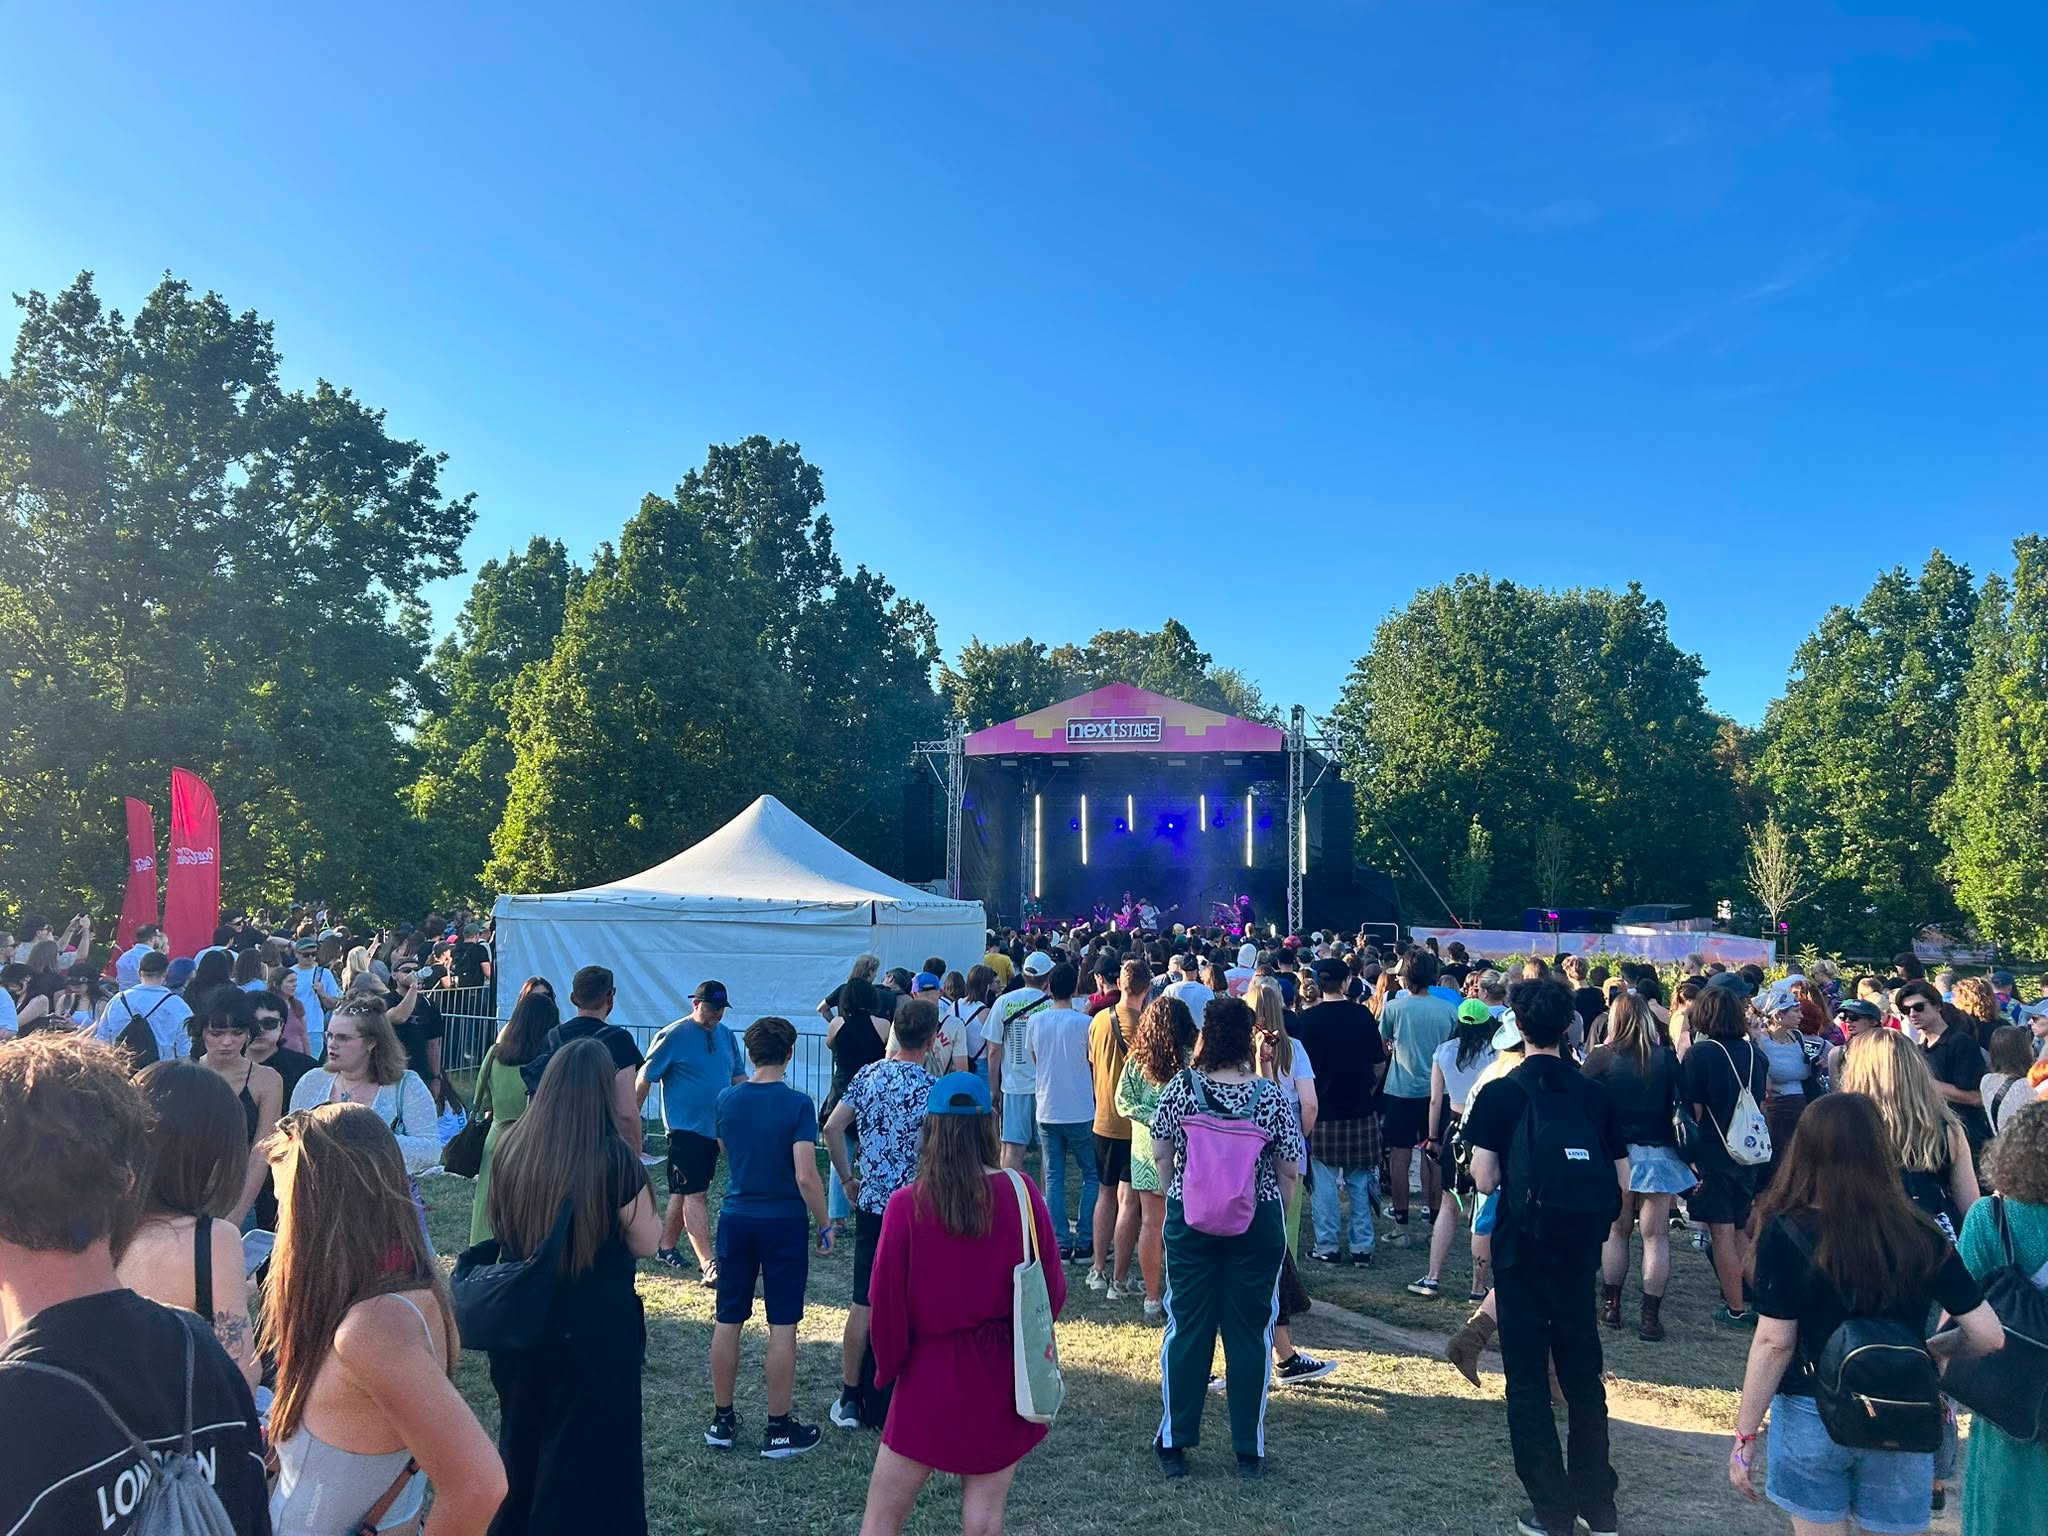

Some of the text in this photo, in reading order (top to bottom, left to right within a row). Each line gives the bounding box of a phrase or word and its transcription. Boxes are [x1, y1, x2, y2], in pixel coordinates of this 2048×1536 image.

[1068, 719, 1156, 739] next STAGE
[771, 1436, 790, 1446] HOKA
[97, 1447, 216, 1530] LONN
